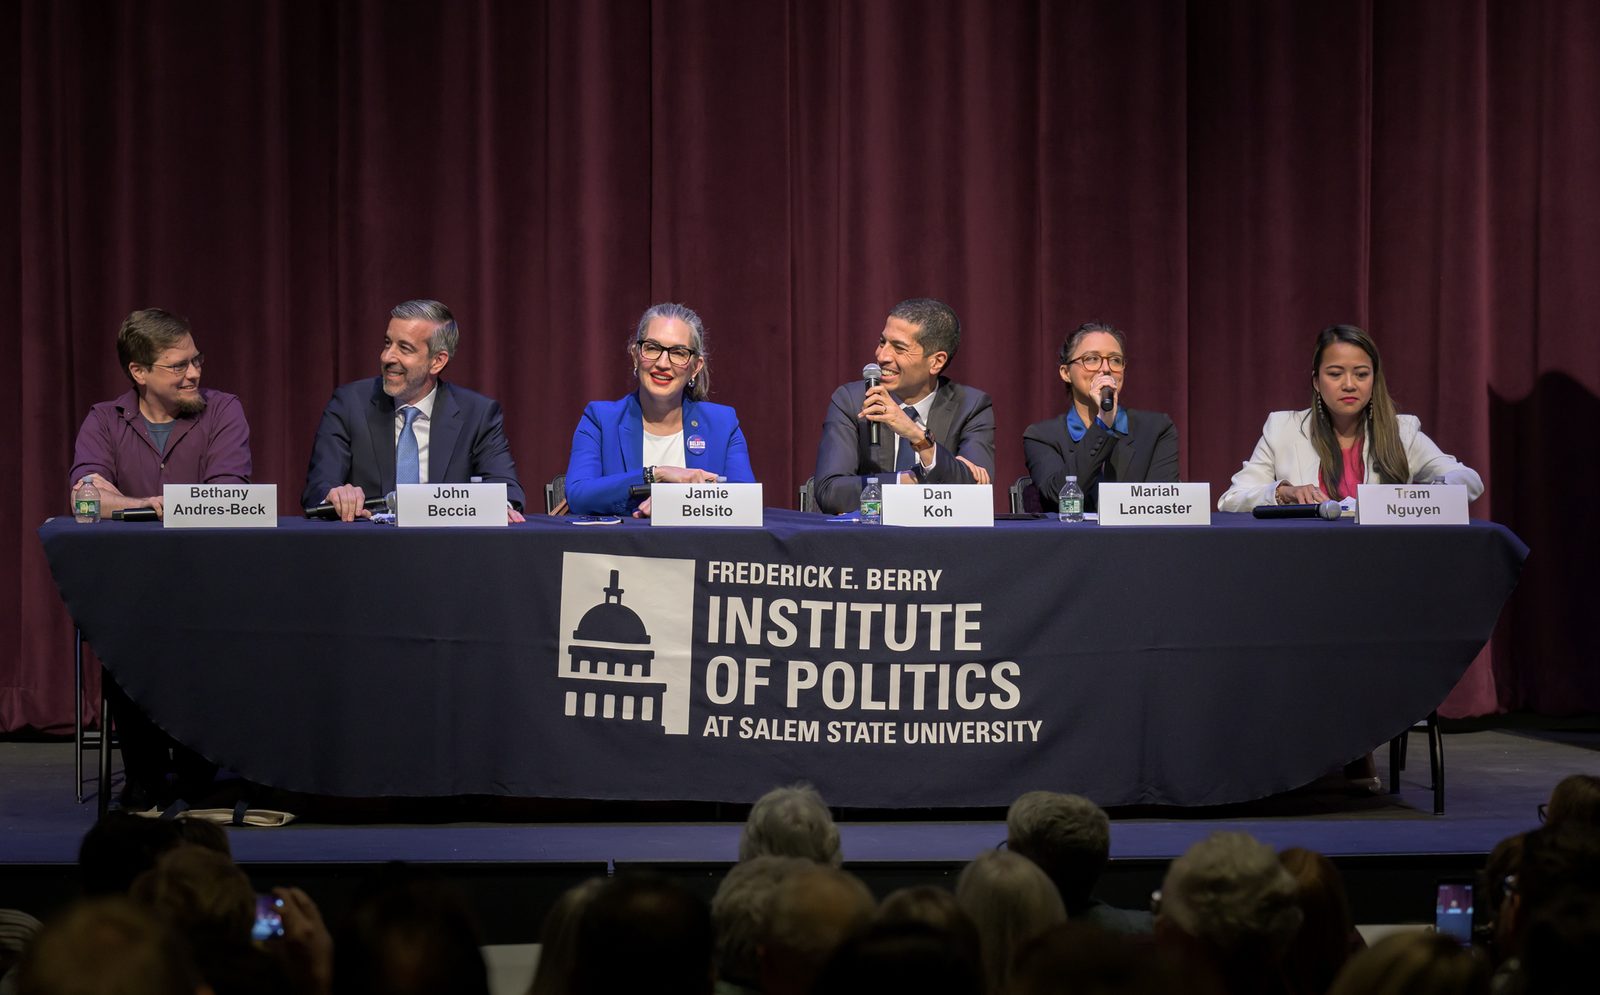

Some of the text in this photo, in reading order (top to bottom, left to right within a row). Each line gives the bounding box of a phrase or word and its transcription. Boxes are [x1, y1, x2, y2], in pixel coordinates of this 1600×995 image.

[190, 486, 249, 501] Bethany
[433, 486, 470, 499] John
[685, 487, 729, 499] Jamie
[923, 488, 952, 500] Dan
[1130, 484, 1180, 497] Mariah
[1394, 487, 1430, 499] Tram
[173, 503, 266, 516] Andres-Beck
[427, 504, 477, 517] Beccia
[682, 504, 733, 517] Belsito
[923, 505, 953, 518] Koh
[1119, 502, 1192, 515] Lancaster
[1386, 503, 1441, 518] Nguyen
[707, 560, 943, 592] FREDERICK E. BERRY
[707, 595, 982, 652] INSTITUTE
[705, 655, 1021, 711] OF POLITICS
[702, 715, 1043, 745] AT SALEM STATE UNIVERSITY
